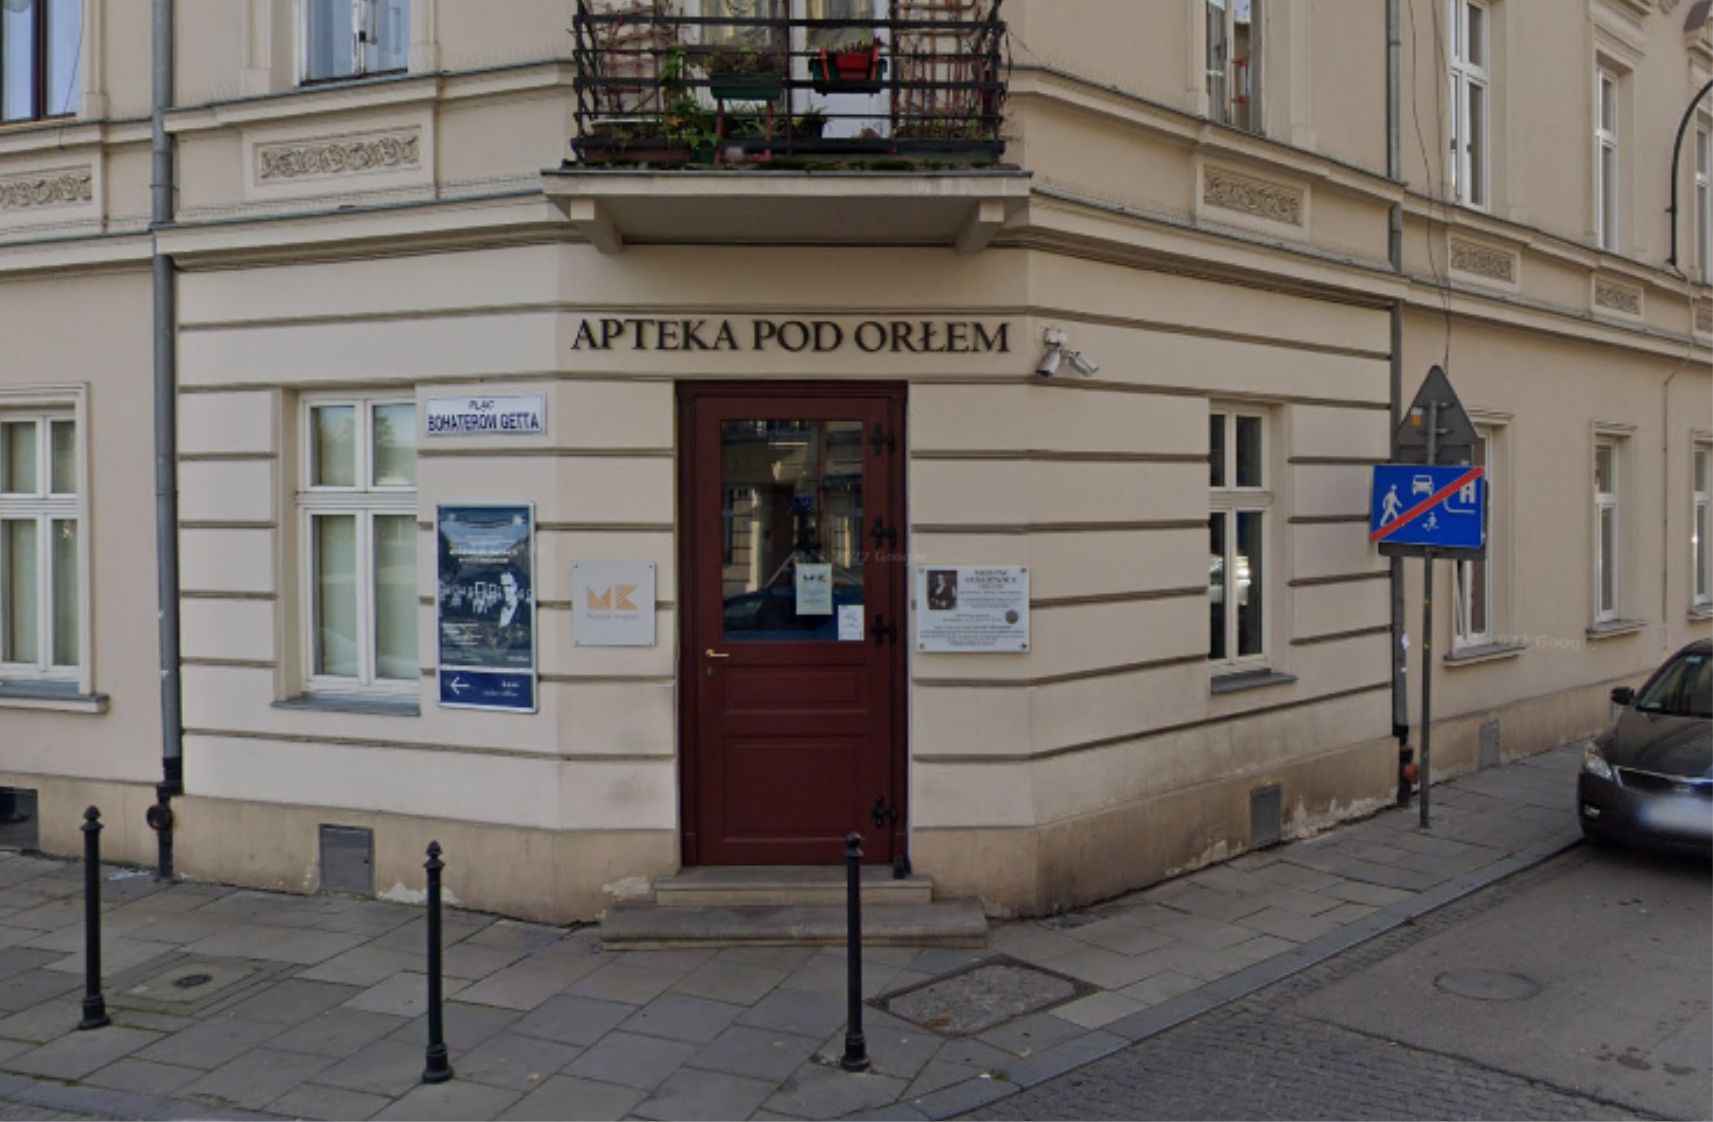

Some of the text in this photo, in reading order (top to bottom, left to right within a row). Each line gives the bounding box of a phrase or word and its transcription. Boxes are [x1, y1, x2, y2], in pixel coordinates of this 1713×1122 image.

[570, 317, 1010, 353] APTEKA POD ORŁEM
[501, 411, 540, 430] GETTA
